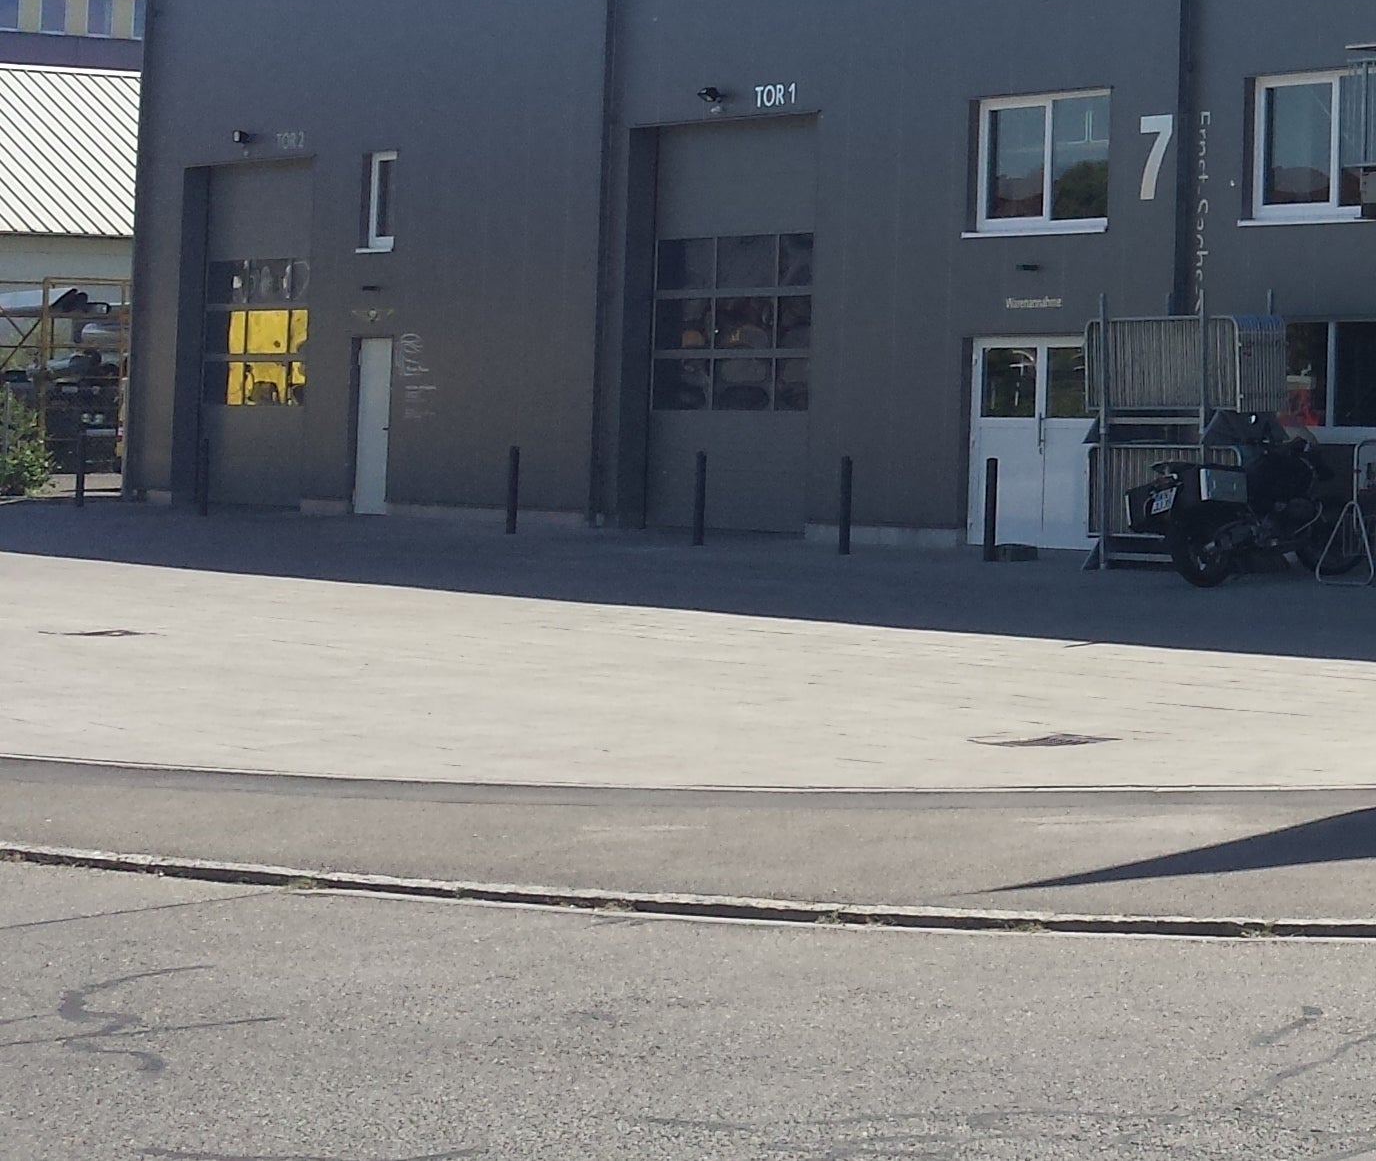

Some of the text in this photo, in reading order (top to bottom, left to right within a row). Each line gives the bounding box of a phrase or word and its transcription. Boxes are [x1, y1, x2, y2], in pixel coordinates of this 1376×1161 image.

[755, 82, 796, 108] TOR 1
[1140, 114, 1173, 200] 7
